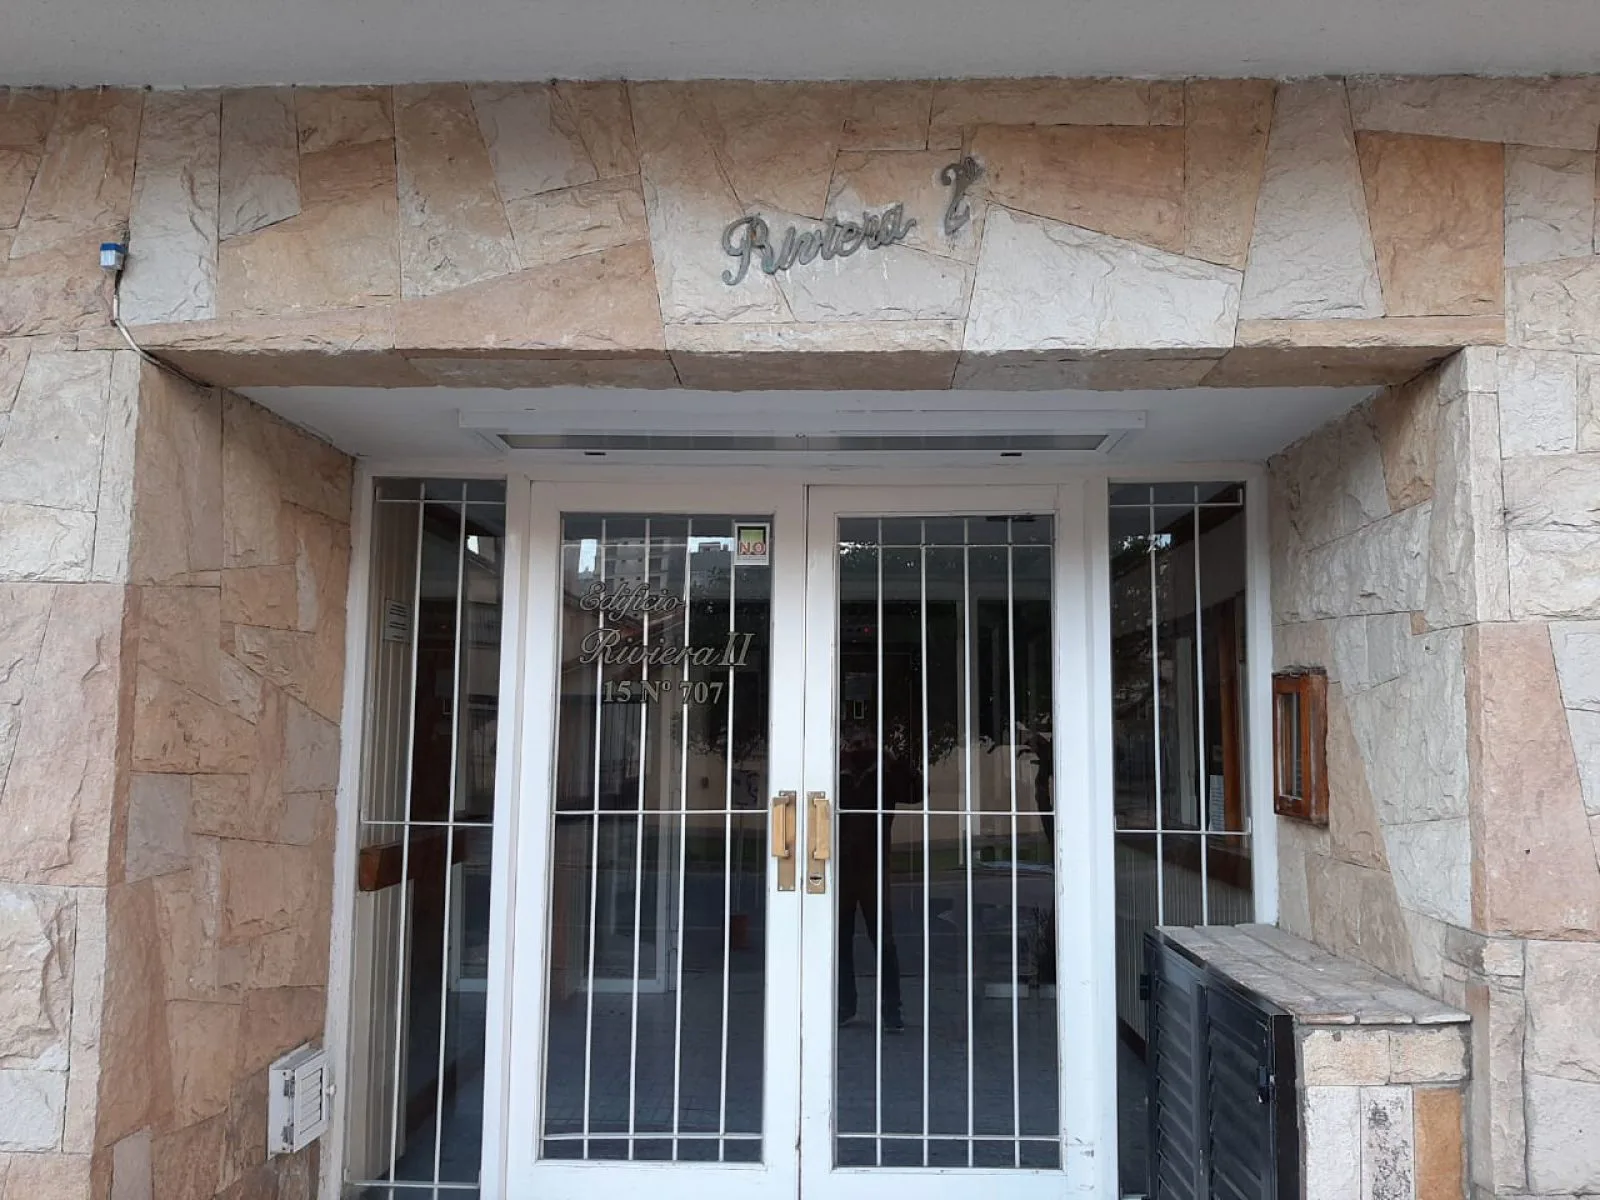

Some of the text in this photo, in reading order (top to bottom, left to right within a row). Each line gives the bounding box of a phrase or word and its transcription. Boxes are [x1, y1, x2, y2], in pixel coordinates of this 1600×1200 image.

[579, 581, 687, 621] Edificio
[579, 628, 757, 666] Riviera II
[603, 680, 632, 703] 15
[679, 681, 724, 704] 707
